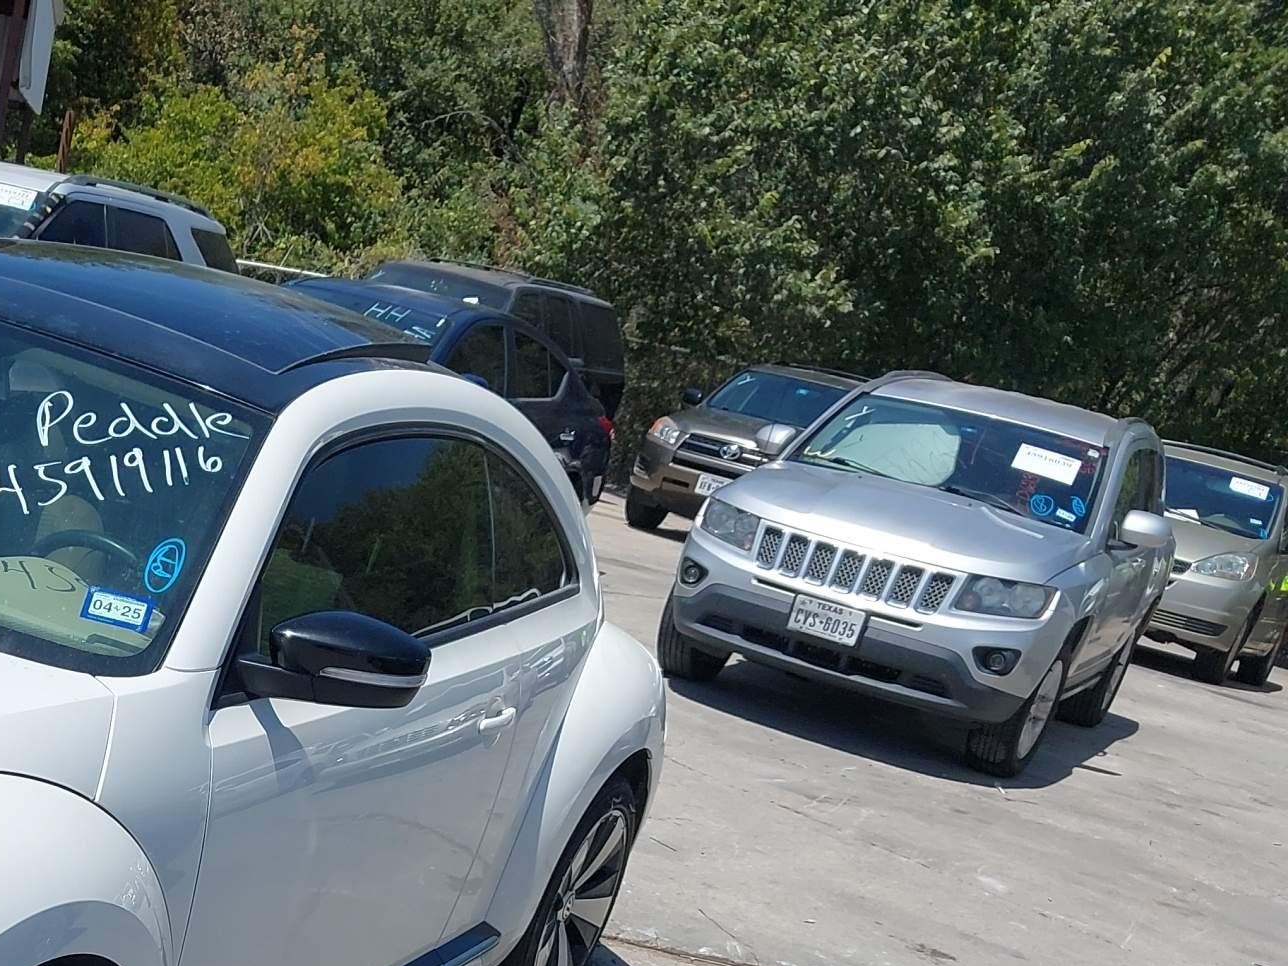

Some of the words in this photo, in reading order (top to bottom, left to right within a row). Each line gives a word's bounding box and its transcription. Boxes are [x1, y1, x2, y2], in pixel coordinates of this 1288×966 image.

[364, 302, 412, 323] HH
[36, 390, 250, 447] Peddle
[817, 602, 844, 615] TEXAS
